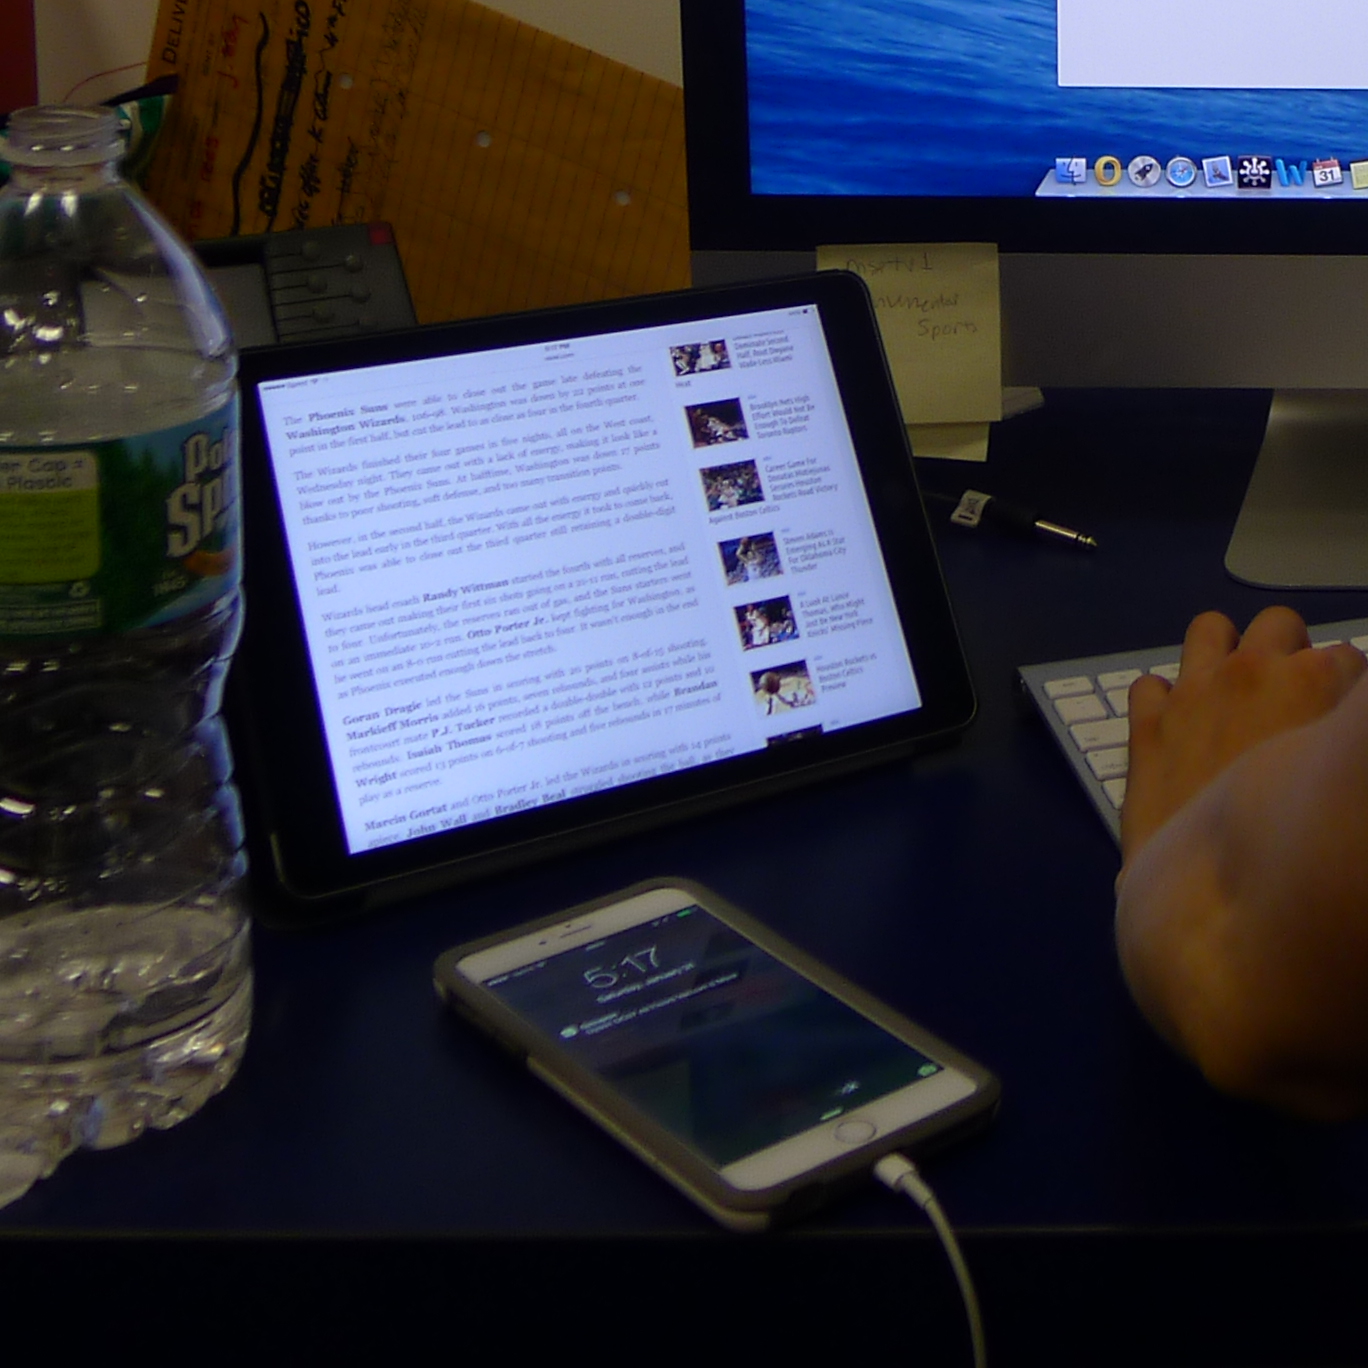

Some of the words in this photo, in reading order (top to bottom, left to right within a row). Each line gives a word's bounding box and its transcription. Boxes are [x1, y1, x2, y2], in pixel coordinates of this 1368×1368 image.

[308, 407, 355, 421] Phoenix
[360, 403, 388, 414] Suns
[285, 422, 355, 441] Washington
[28, 457, 67, 475] Cap
[7, 476, 72, 489] Plastic
[422, 587, 458, 602] Randy
[460, 578, 509, 595] Wittman
[466, 626, 493, 640] Otto
[494, 619, 530, 634] Porter
[399, 712, 440, 729] Morris
[447, 733, 493, 750] Thomas
[355, 771, 398, 789] Wright
[583, 943, 659, 989] 5:17
